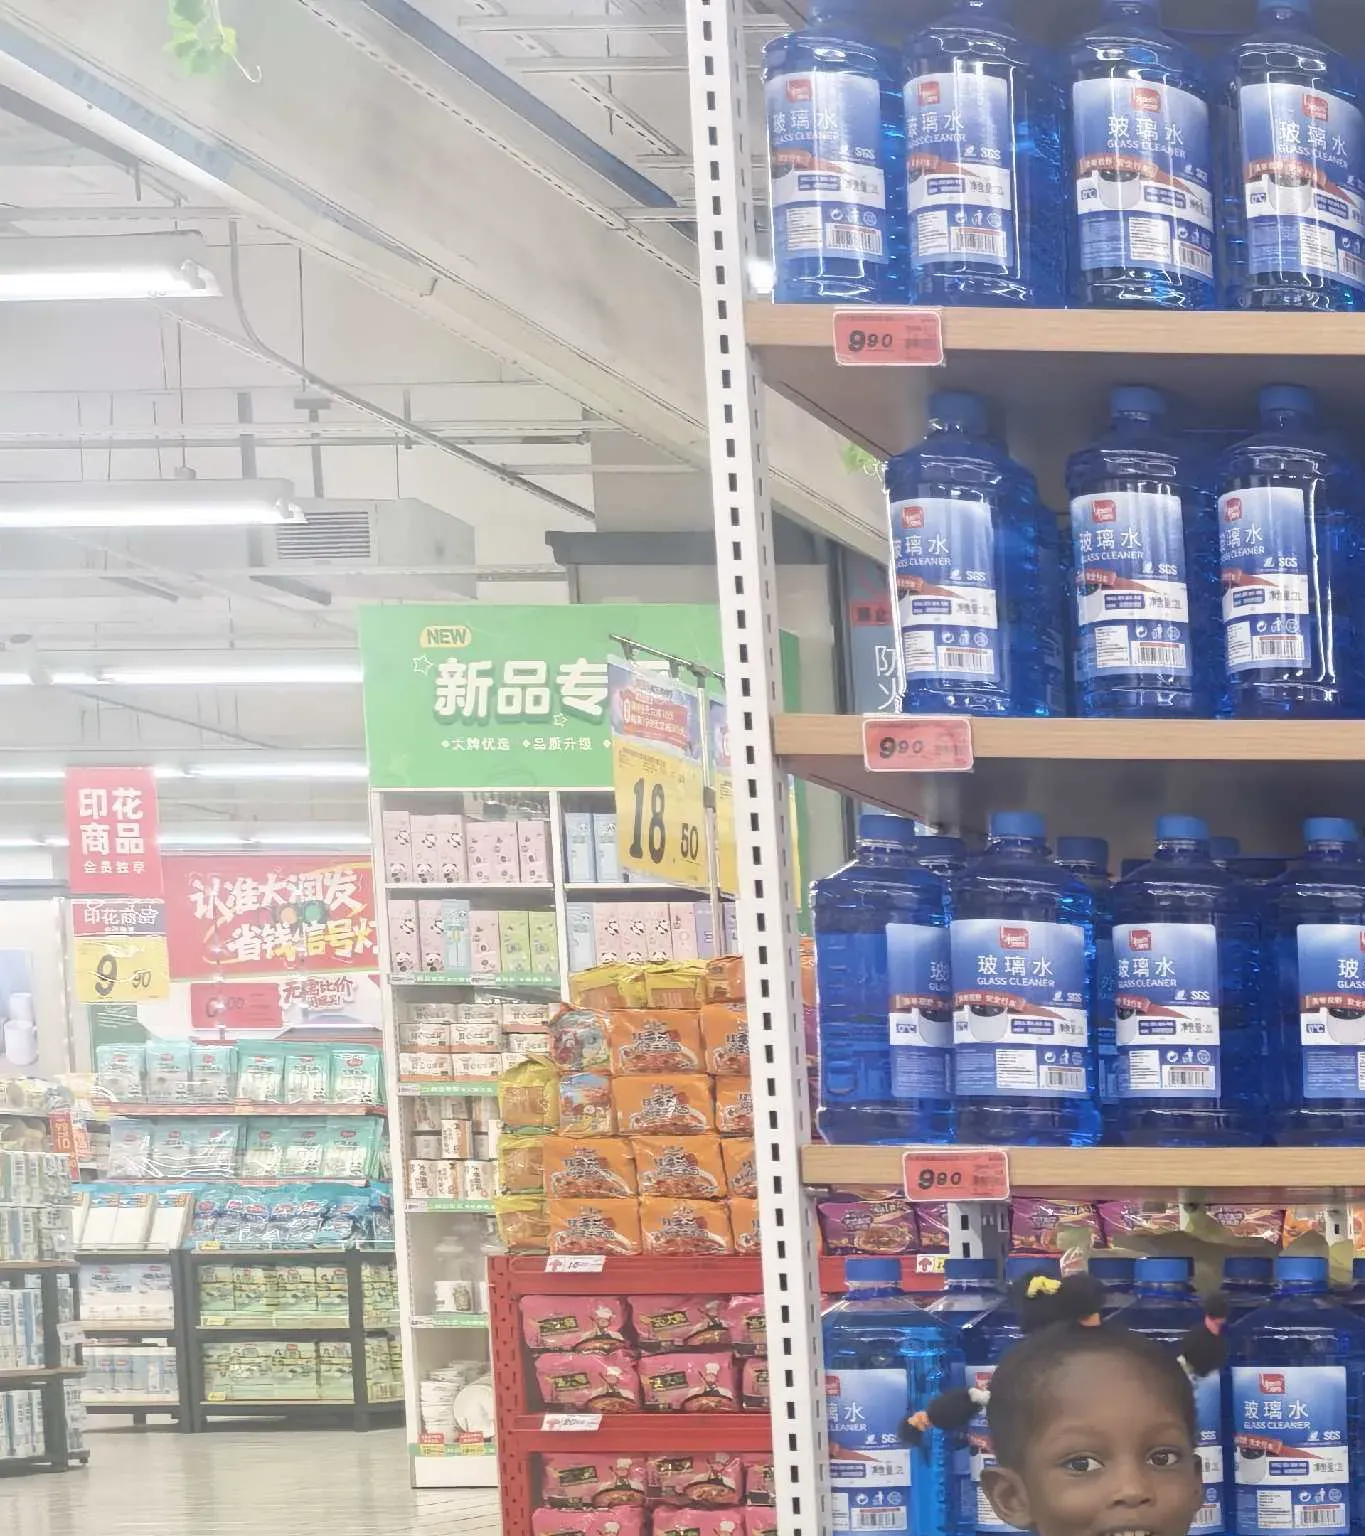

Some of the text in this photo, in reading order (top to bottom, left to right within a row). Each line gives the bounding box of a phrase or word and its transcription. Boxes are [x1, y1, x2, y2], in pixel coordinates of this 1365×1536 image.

[1108, 115, 1183, 146] 玻璃水
[1279, 121, 1346, 157] 玻璃水
[981, 148, 1001, 160] SGS
[1158, 562, 1177, 574] SGS
[1279, 557, 1298, 568] SGS
[967, 570, 987, 582] SGS
[426, 628, 467, 646] NEW
[434, 657, 672, 719] 新品专
[452, 737, 511, 751] 大牌优选
[78, 786, 145, 822] 印花
[628, 777, 666, 864] 18
[80, 822, 146, 857] 商品
[189, 870, 367, 927] 认准大润发
[227, 925, 380, 962] 省钱信号灯
[977, 955, 1055, 977] 玻璃水
[95, 954, 118, 998] 9
[977, 976, 1056, 988] GLASS CLEANER
[1067, 991, 1083, 1001] SGS
[1191, 990, 1210, 1001] SGS
[1244, 1400, 1309, 1420] 玻璃水
[1267, 1421, 1311, 1430] CLEANER
[1324, 1430, 1341, 1441] SGS
